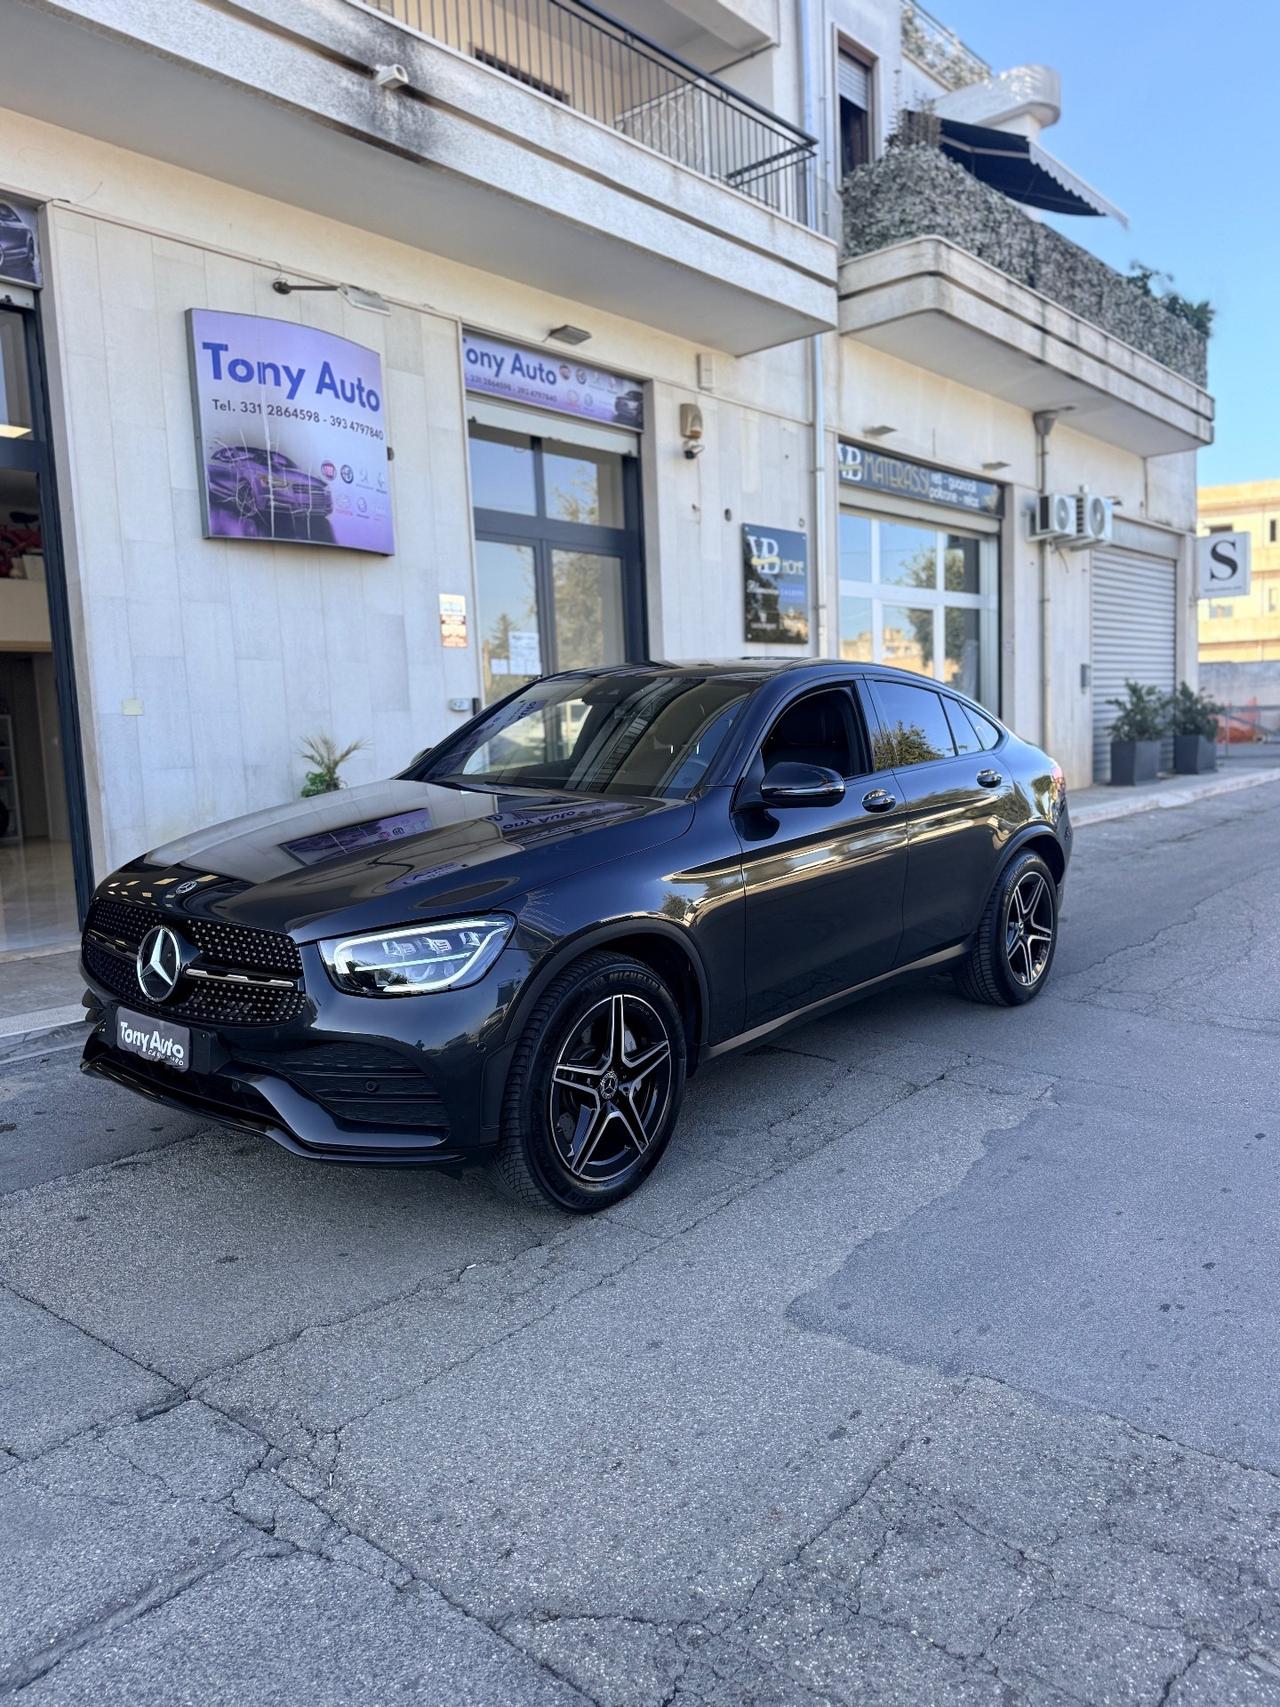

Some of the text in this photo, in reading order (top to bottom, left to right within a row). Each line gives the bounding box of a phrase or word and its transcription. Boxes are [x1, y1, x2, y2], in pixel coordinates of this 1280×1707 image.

[202, 341, 380, 412] Tony Auto
[464, 342, 557, 386] ony Auto
[212, 399, 236, 412] Tel.
[240, 402, 262, 415] 331
[267, 404, 320, 423] 2864598
[330, 415, 348, 430] 393
[350, 423, 384, 440] 4797840
[1209, 539, 1238, 581] S
[120, 1021, 185, 1059] Tony Auto
